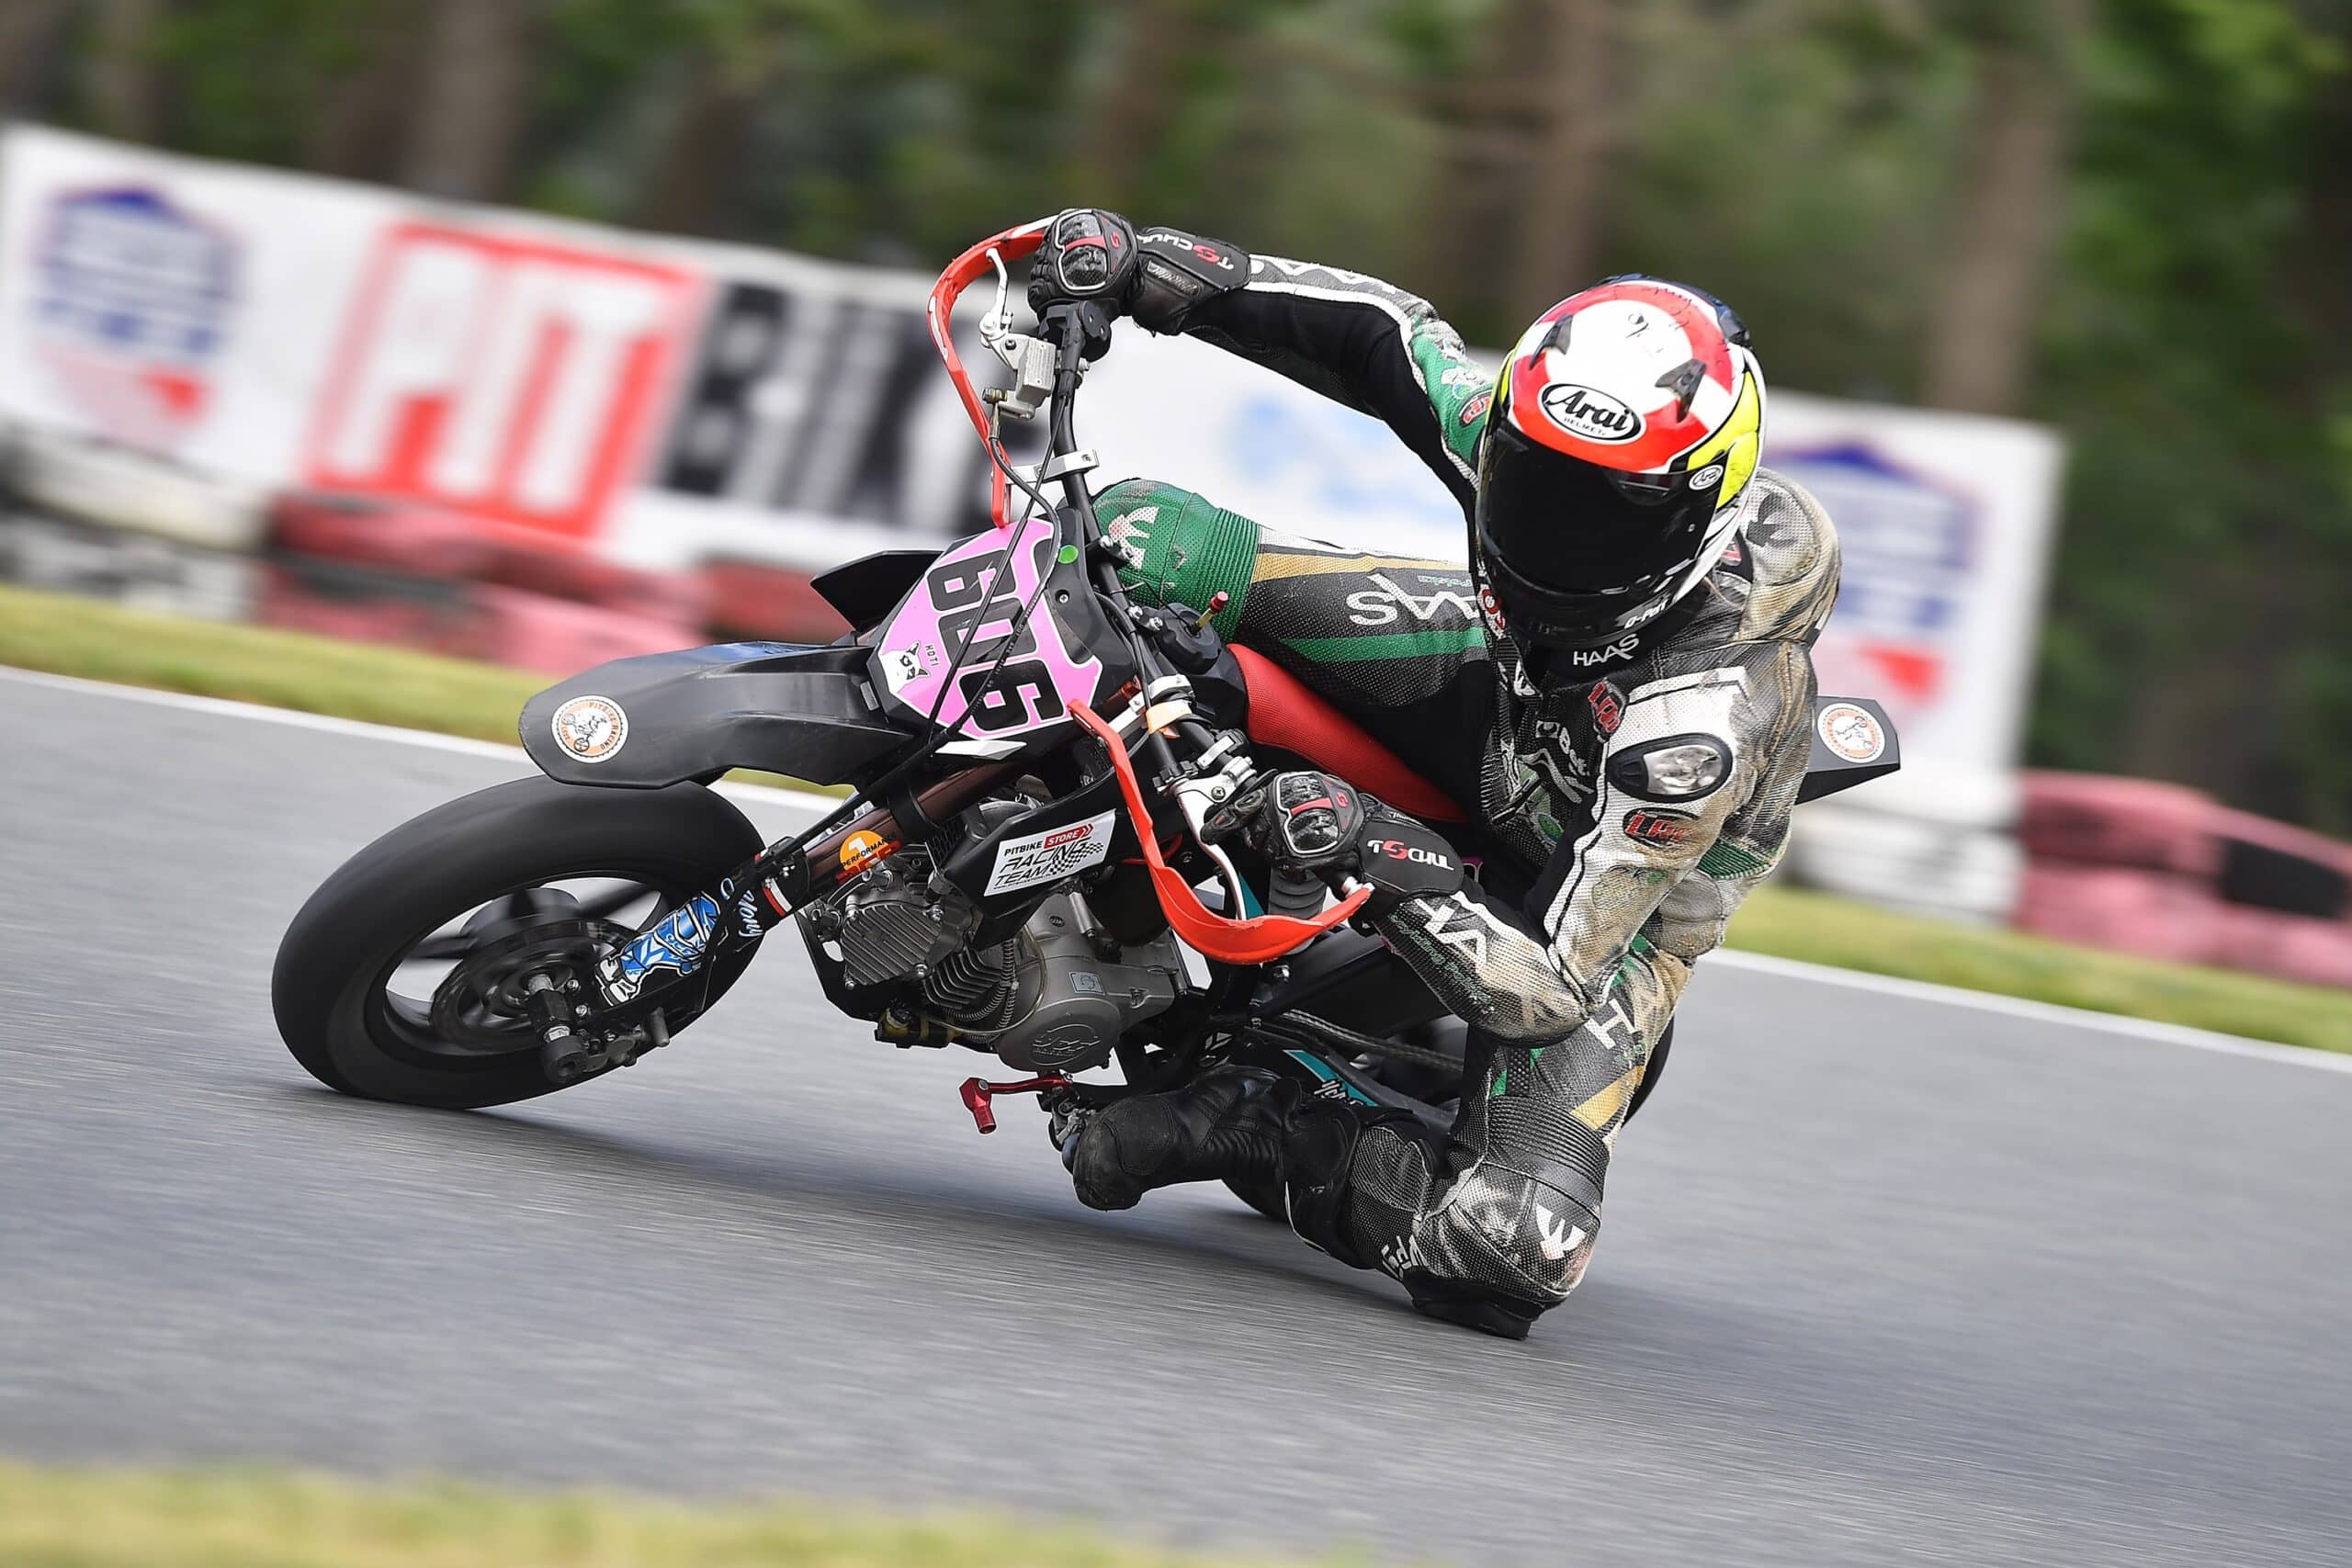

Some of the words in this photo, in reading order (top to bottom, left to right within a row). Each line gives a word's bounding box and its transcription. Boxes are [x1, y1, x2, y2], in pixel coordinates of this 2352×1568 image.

[323, 242, 675, 517] PIT
[1544, 389, 1629, 432] Arai
[1346, 573, 1480, 626] AAS
[926, 548, 1066, 732] 606
[1573, 634, 1640, 667] HAAS
[1000, 836, 1091, 874] RACING
[1003, 840, 1044, 857] PITBIKE
[1047, 830, 1080, 846] STORE
[994, 863, 1051, 886] TEAM
